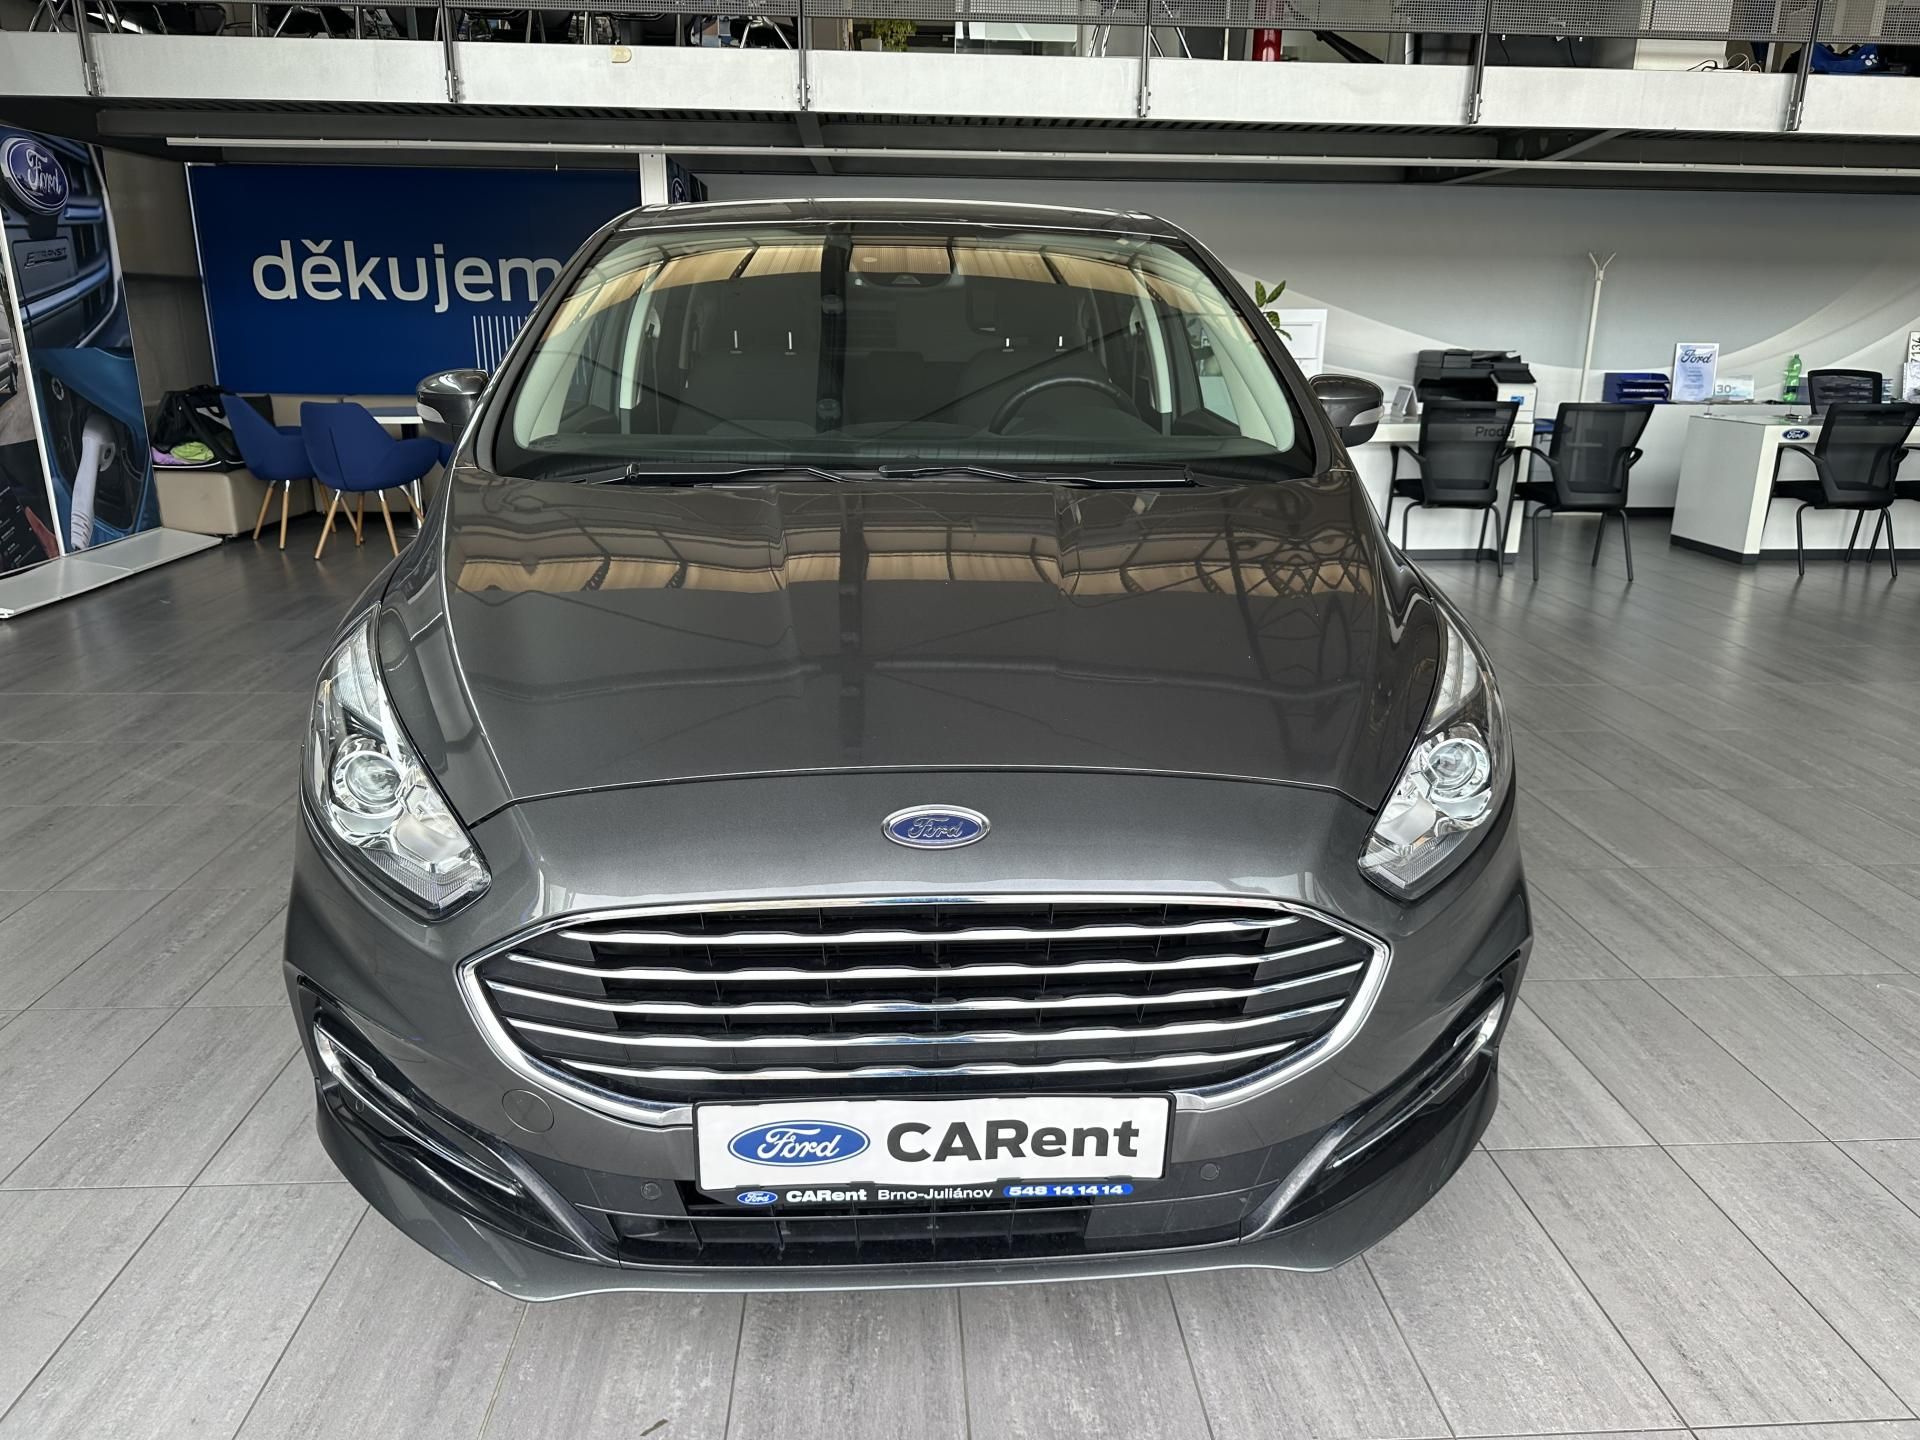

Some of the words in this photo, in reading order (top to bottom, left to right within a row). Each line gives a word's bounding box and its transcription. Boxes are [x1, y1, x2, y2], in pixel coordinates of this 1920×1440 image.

[26, 148, 62, 195] Ford
[1680, 349, 1713, 364] Ford
[1475, 425, 1516, 439] Prodj
[907, 817, 964, 838] Ford
[757, 1127, 842, 1159] Ford
[887, 1119, 1140, 1163] CARent
[744, 1191, 771, 1204] Ford
[786, 1188, 868, 1203] CARent
[877, 1187, 994, 1201] Brno-Juliánov
[1008, 1185, 1048, 1196] 548
[1053, 1185, 1075, 1196] 14
[1077, 1185, 1099, 1195] 14
[1101, 1184, 1123, 1194] 14
